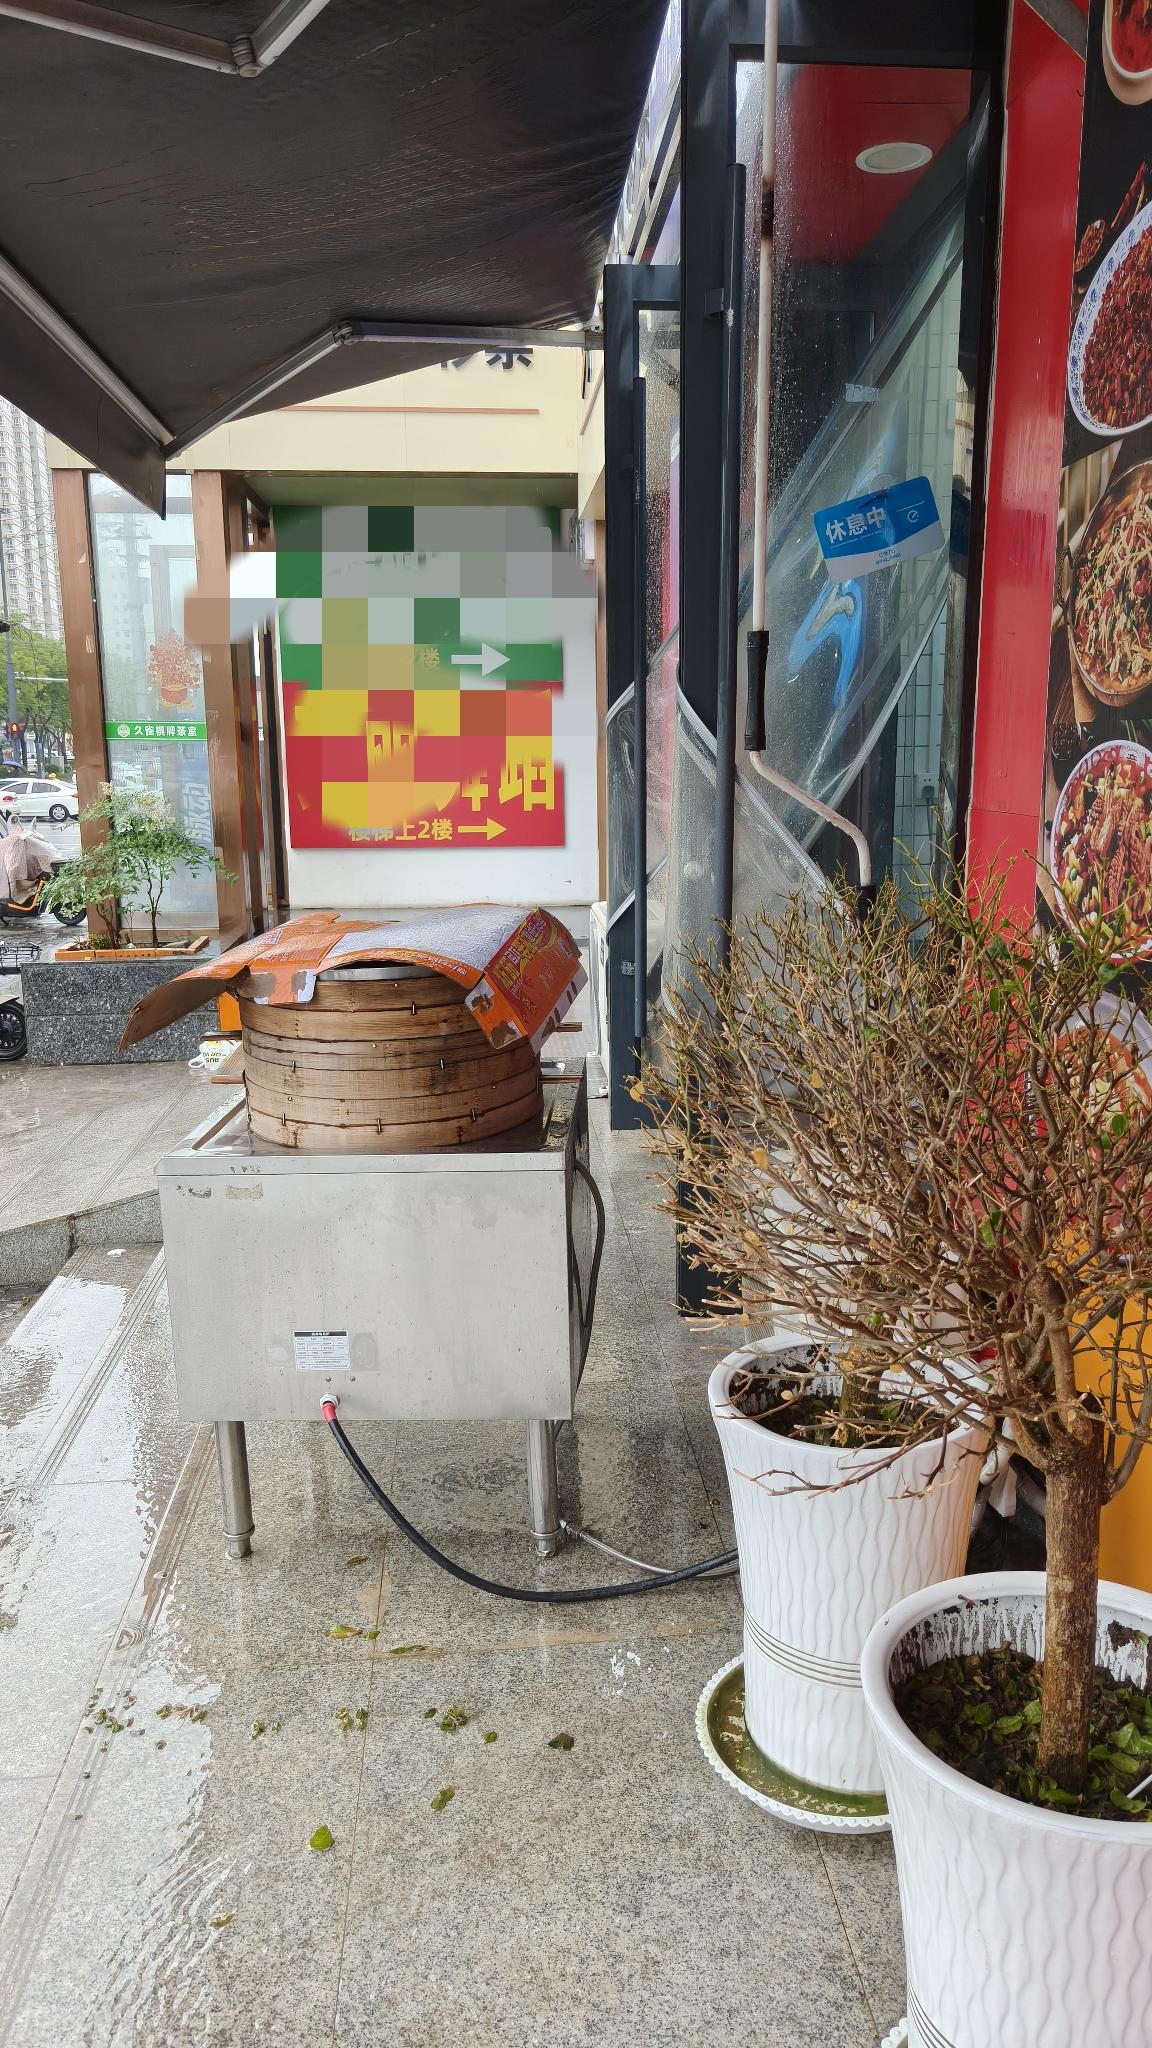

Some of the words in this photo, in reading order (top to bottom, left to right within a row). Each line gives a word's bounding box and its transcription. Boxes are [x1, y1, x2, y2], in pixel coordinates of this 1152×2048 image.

[825, 506, 887, 544] 休息中
[134, 725, 197, 737] 久雀棋牌茶室
